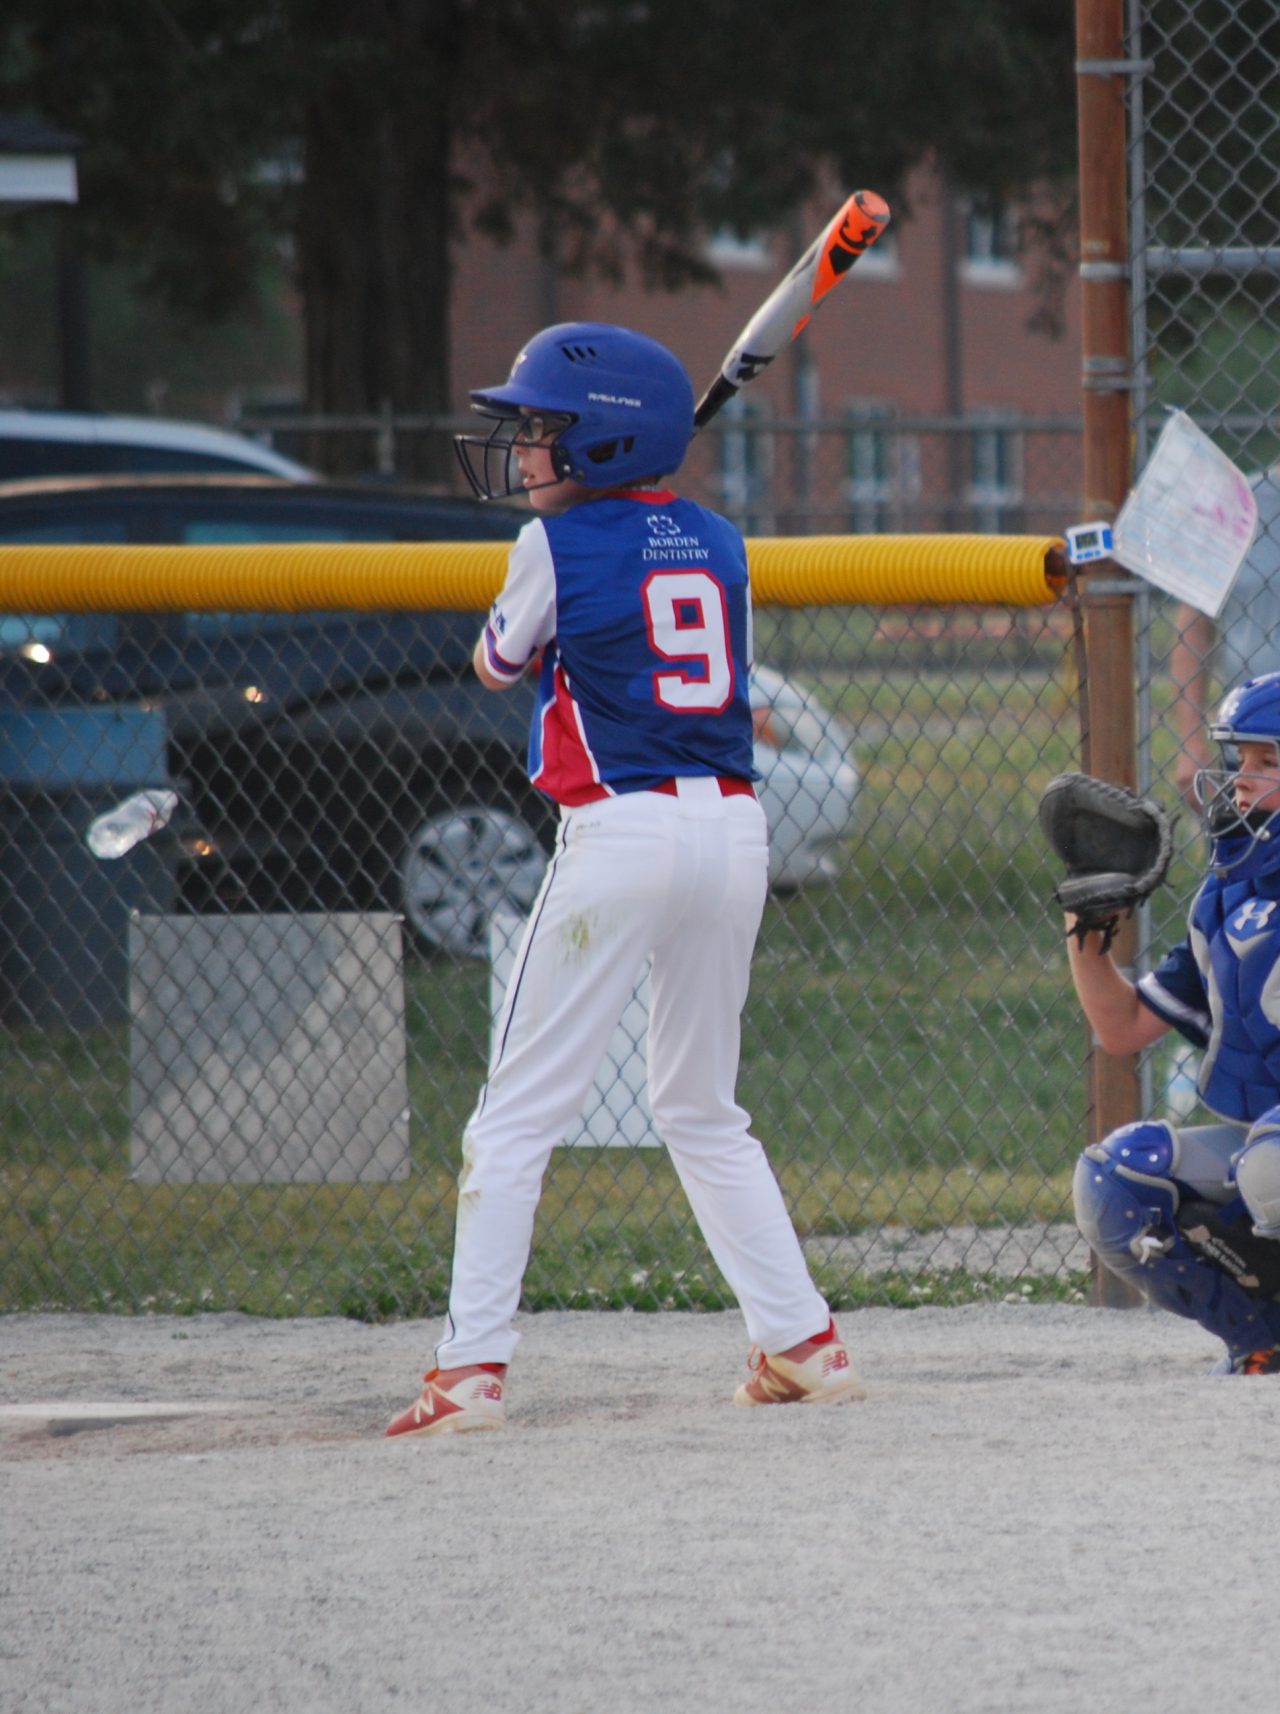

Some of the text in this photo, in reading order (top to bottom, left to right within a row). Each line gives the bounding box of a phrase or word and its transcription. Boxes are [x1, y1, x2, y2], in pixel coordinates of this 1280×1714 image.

[648, 536, 700, 548] BORDEN
[642, 548, 709, 561] DENTISTRY
[640, 567, 735, 715] 9
